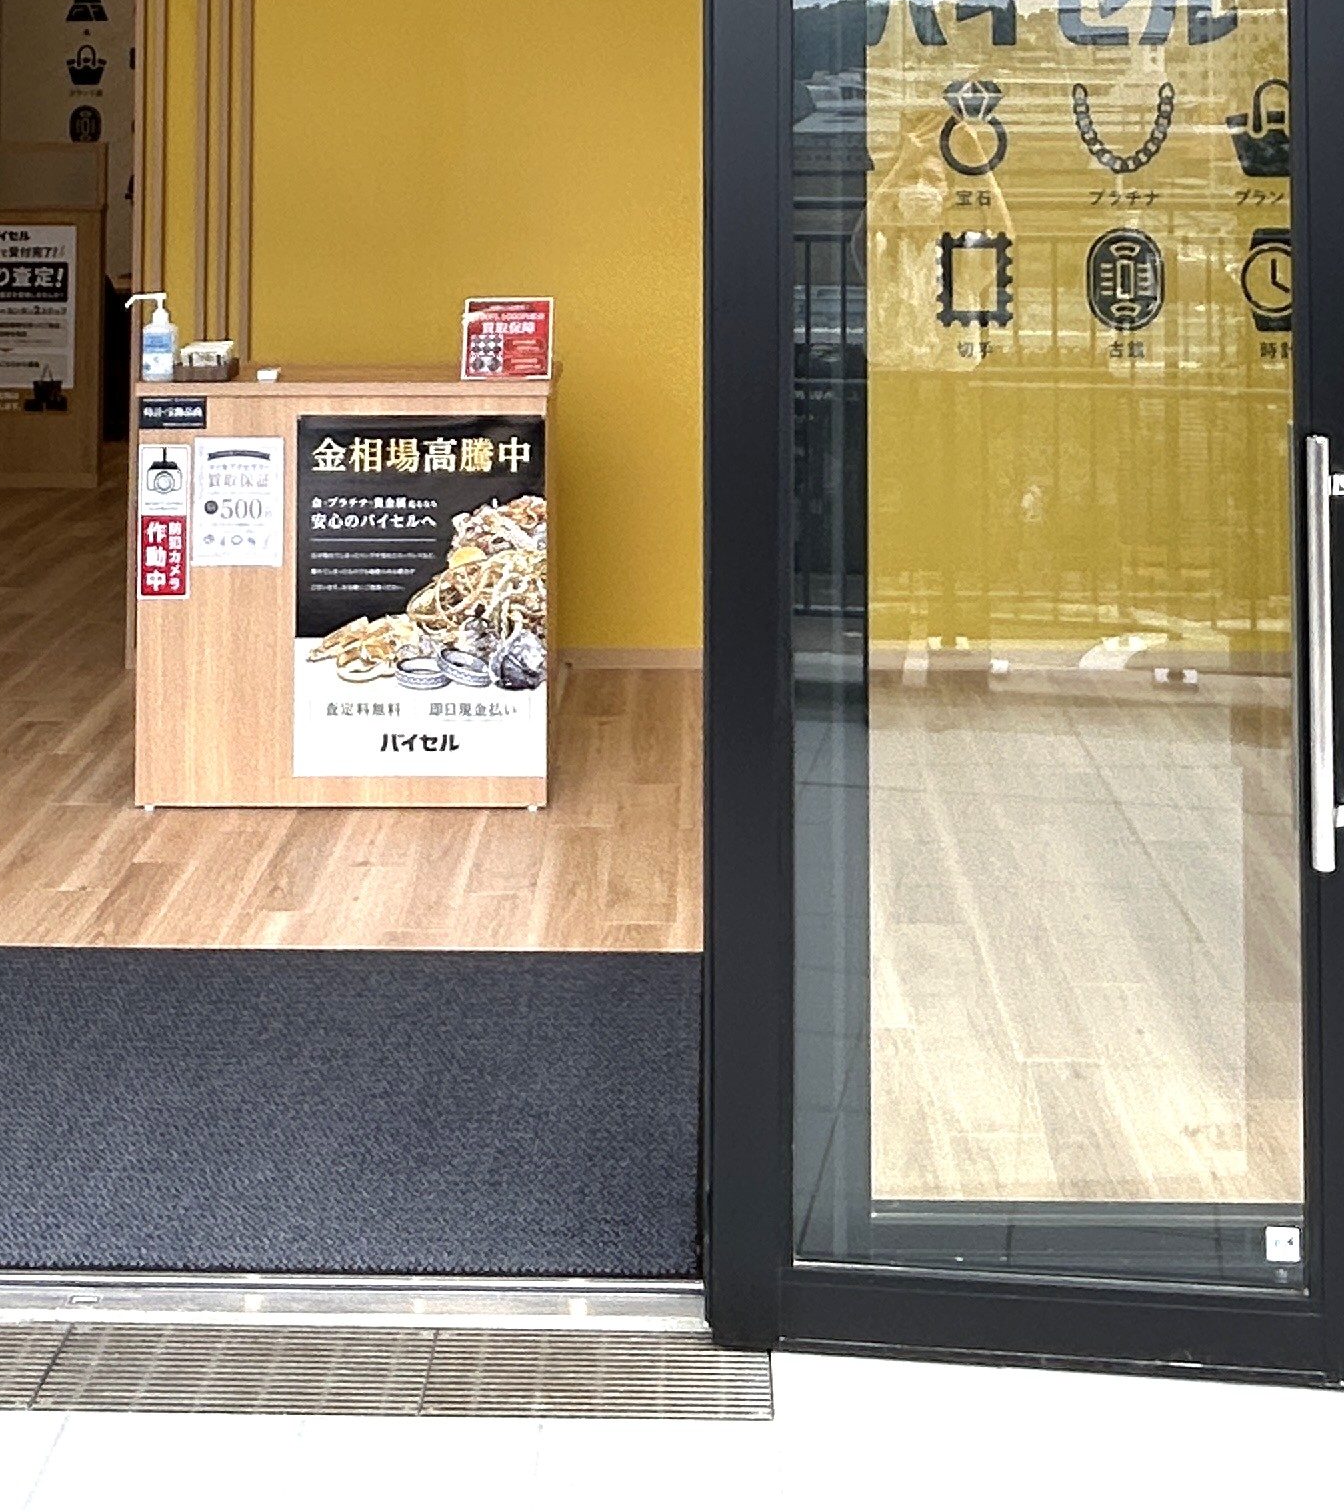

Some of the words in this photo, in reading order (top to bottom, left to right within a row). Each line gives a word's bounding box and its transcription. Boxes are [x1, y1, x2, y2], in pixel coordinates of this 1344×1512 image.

[956, 189, 992, 207] 宝石
[311, 436, 532, 473] 金相場高騰中
[310, 512, 438, 530] 安心のバイセルへ
[379, 733, 460, 752] バイセル
